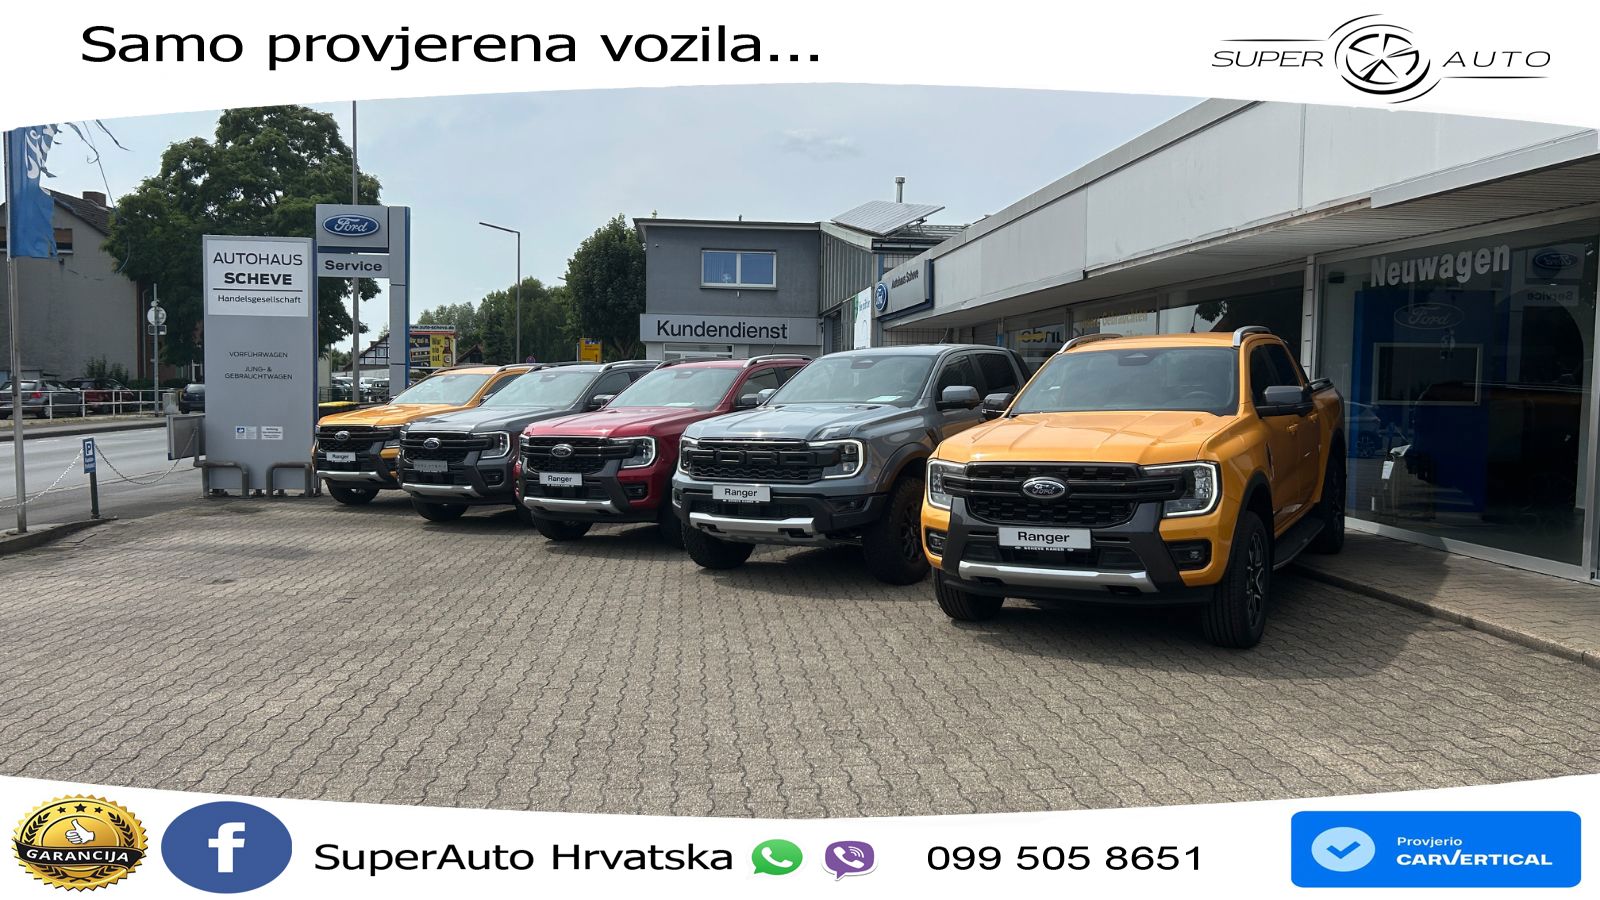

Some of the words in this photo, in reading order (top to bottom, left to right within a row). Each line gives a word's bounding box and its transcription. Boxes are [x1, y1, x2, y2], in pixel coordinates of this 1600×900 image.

[334, 217, 368, 232] Ford
[212, 251, 303, 266] AUTOHAUS
[324, 260, 383, 272] Service
[1370, 244, 1510, 287] Neuwagen
[223, 272, 293, 286] SCHEVE
[217, 294, 302, 304] Handelsgesellschaft
[1407, 305, 1450, 326] Ford
[657, 320, 788, 340] Kundendienst
[87, 442, 92, 454] P
[547, 475, 573, 483] Ranger
[724, 487, 758, 498] Ranger
[1031, 483, 1056, 495] Ford
[1017, 531, 1070, 543] Ranger
